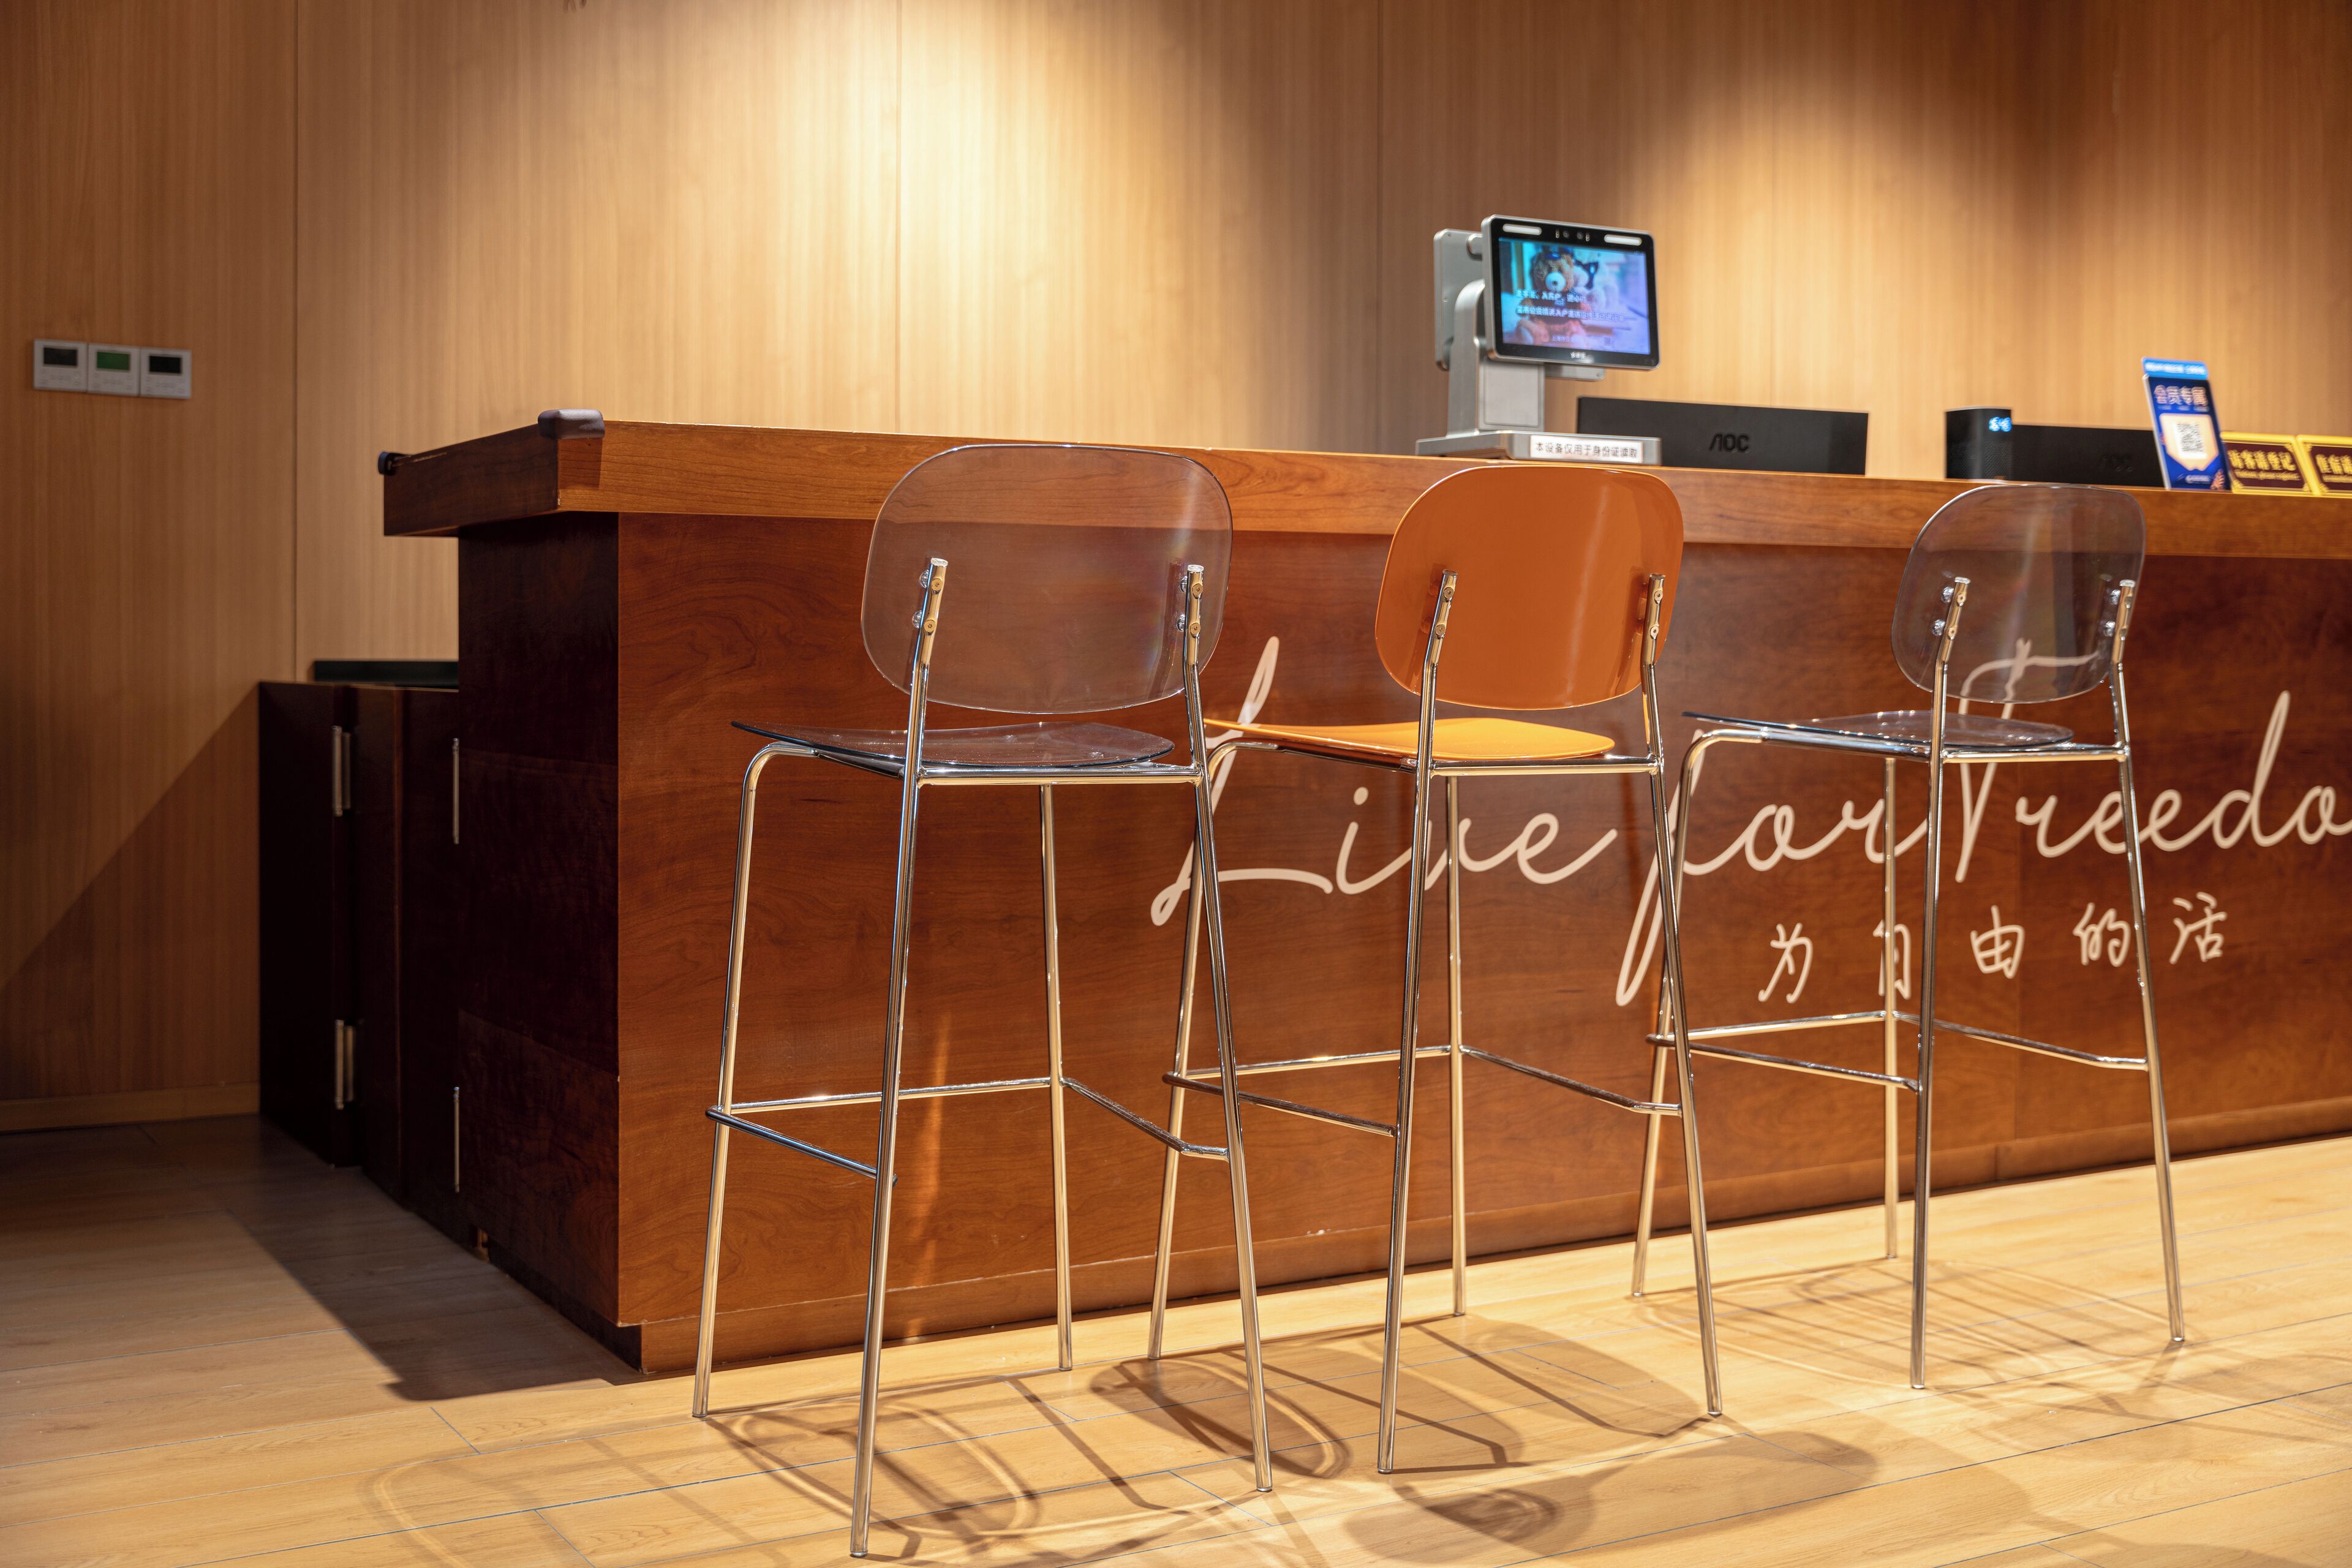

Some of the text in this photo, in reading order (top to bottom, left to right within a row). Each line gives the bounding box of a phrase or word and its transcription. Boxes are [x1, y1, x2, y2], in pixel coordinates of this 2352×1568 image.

[1709, 433, 1750, 452] AOC
[1150, 636, 1618, 927] Live
[1954, 638, 2352, 883] Freedo
